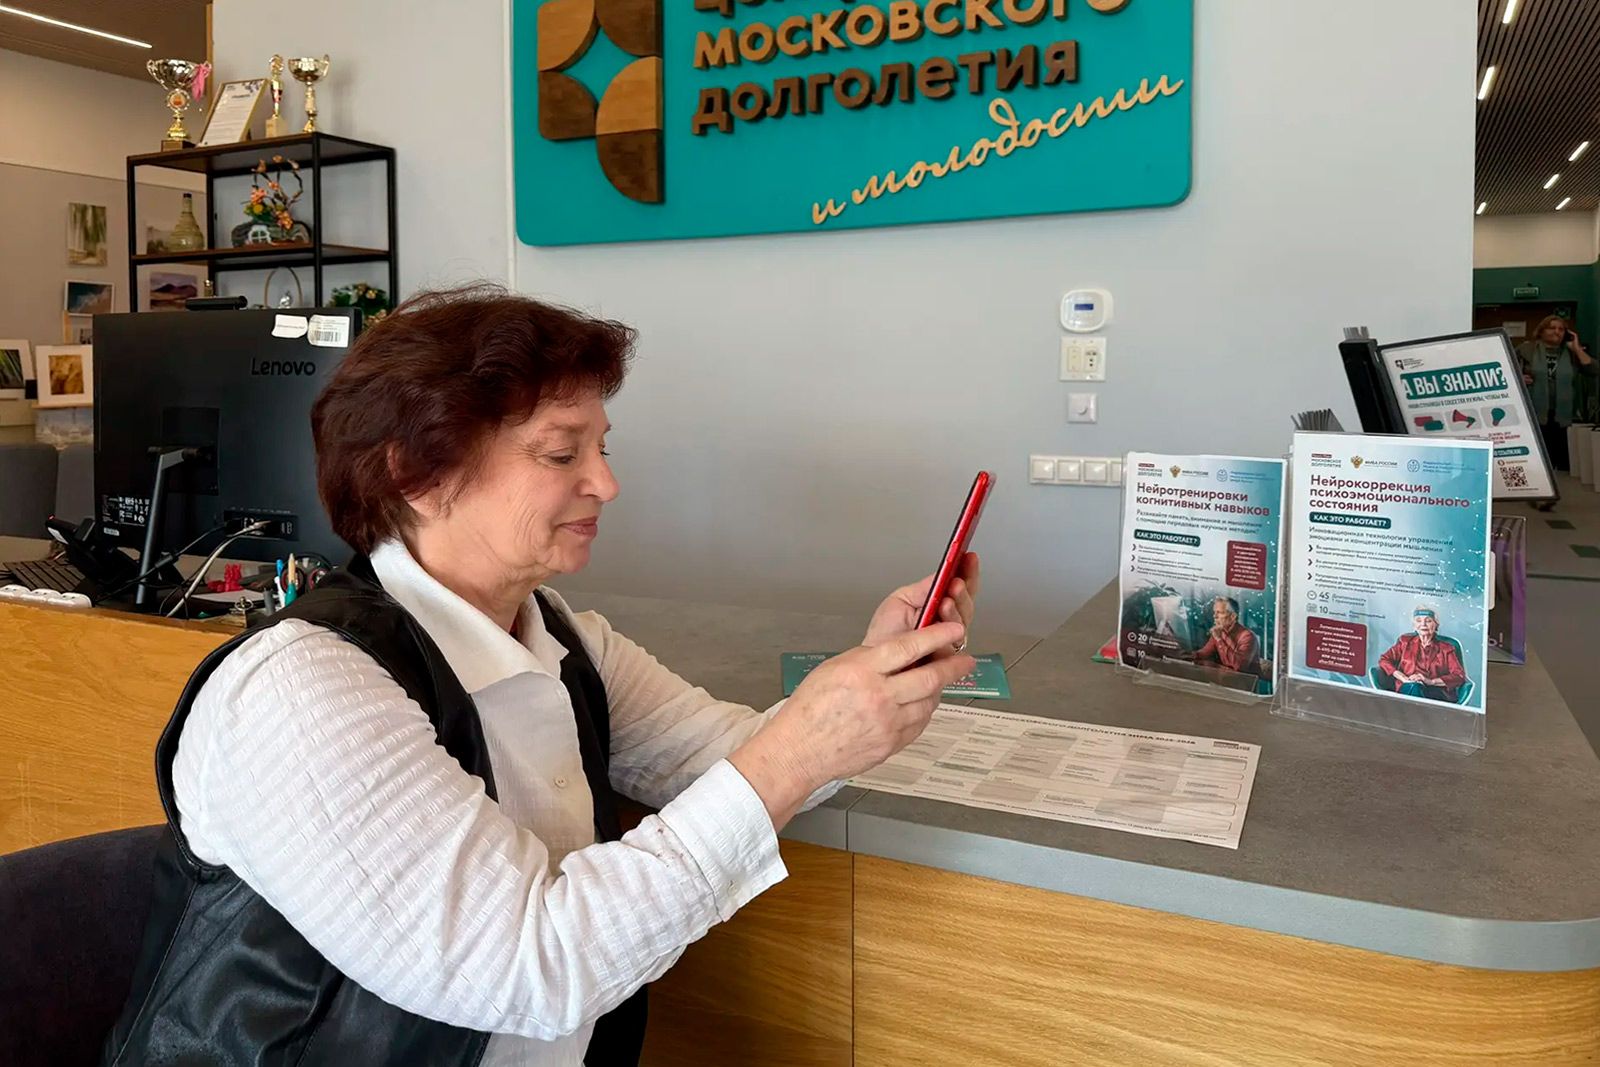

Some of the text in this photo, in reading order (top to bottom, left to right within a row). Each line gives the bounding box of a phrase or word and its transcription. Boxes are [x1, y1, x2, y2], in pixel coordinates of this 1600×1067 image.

[811, 74, 1185, 225] и молодости
[251, 357, 316, 377] Lenovo
[1414, 376, 1440, 396] ВЫ
[1441, 368, 1507, 393] ЗНАЛИ?
[1136, 482, 1249, 502] Нейротренировки
[1310, 474, 1431, 494] Нейрокоррекция
[1136, 495, 1270, 517] когнитивных навыков
[1309, 487, 1471, 508] психоэмоционального
[1309, 499, 1379, 513] состояния
[1313, 514, 1387, 527] КАК ЭТО РАБОТАЕТ?
[1136, 531, 1149, 539] КАК
[1365, 532, 1407, 541] технология
[1319, 591, 1330, 600] 45
[1319, 606, 1329, 614] 10
[1138, 633, 1148, 642] 20
